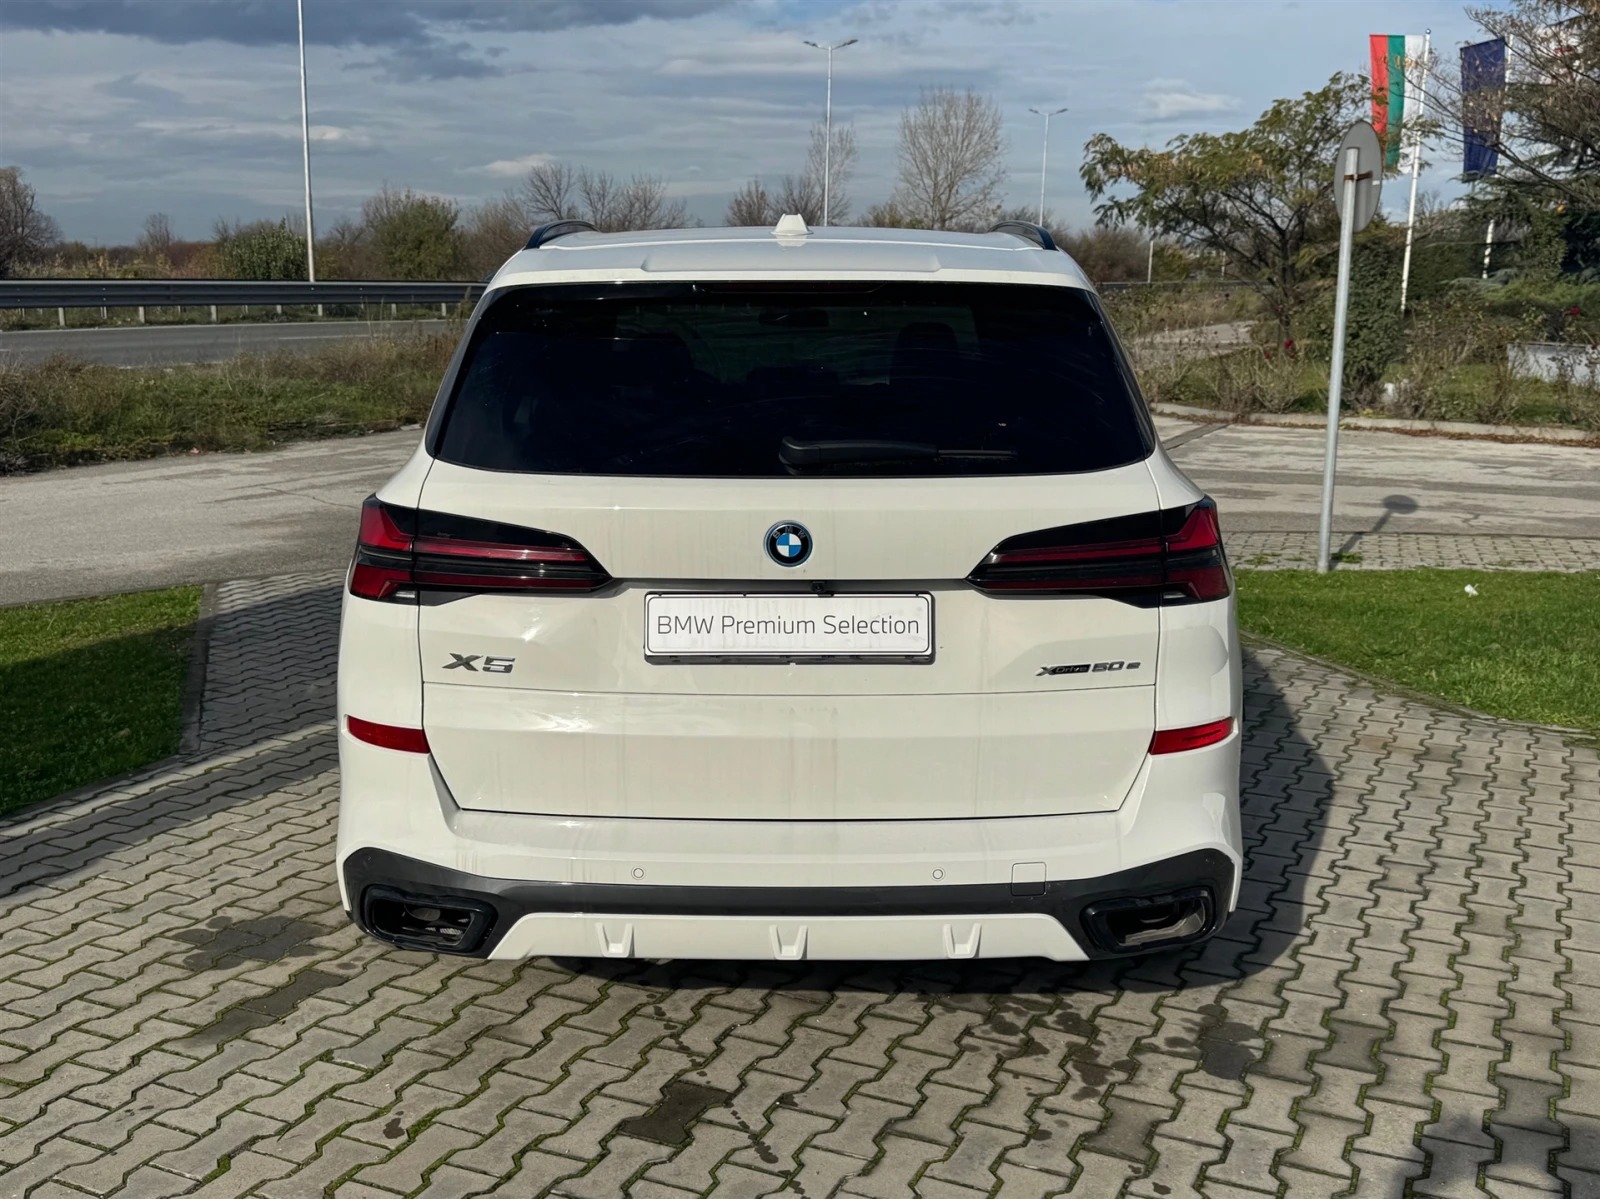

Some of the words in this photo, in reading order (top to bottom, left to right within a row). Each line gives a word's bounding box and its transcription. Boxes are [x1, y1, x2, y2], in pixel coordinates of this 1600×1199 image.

[772, 526, 806, 539] BMW
[657, 615, 714, 635] BMW
[721, 615, 816, 635] Premium
[823, 614, 920, 635] Selection
[442, 652, 516, 674] X5
